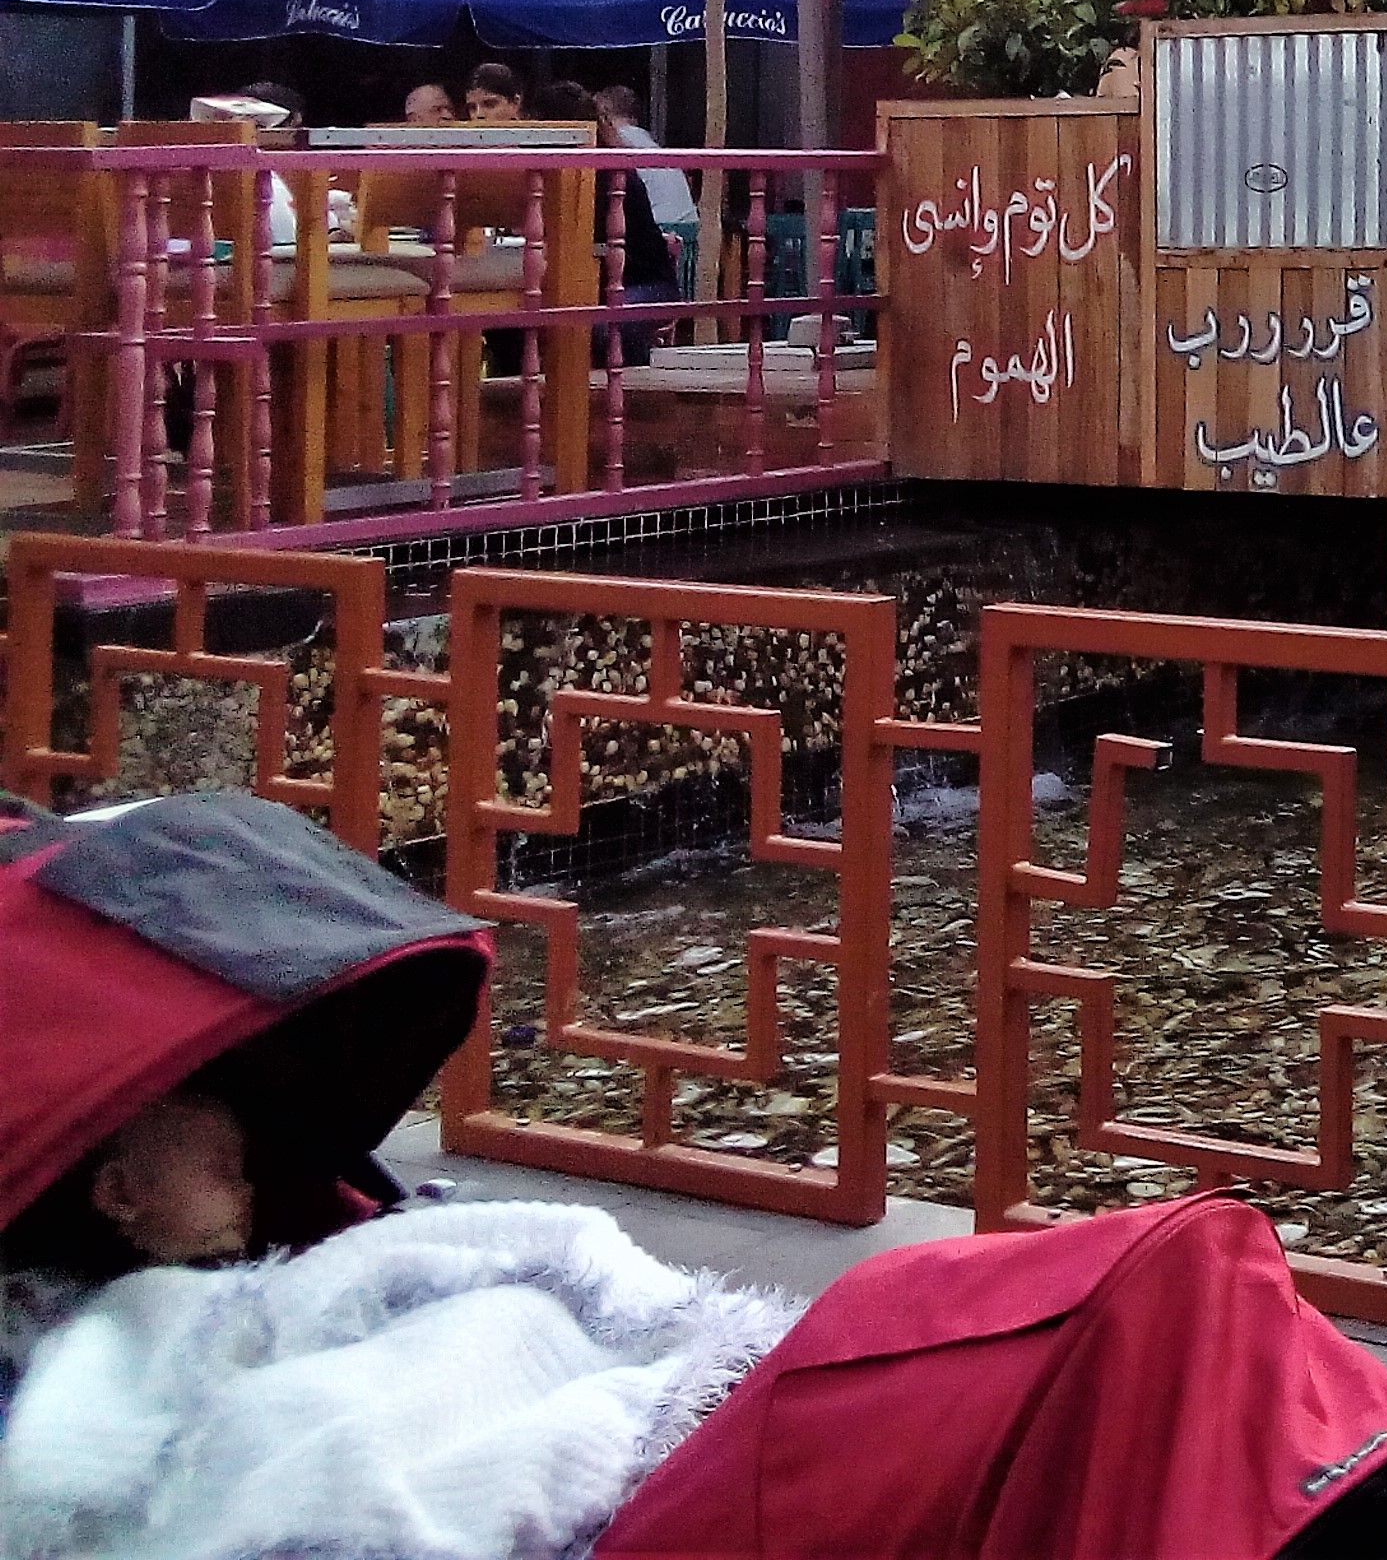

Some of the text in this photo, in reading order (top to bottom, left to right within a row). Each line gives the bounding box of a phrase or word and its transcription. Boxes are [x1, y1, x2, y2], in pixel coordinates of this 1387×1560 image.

[1003, 176, 1057, 286] توم
[1058, 153, 1133, 262] كل
[951, 309, 1077, 424] الهموم
[1197, 375, 1379, 488] عالطيب
